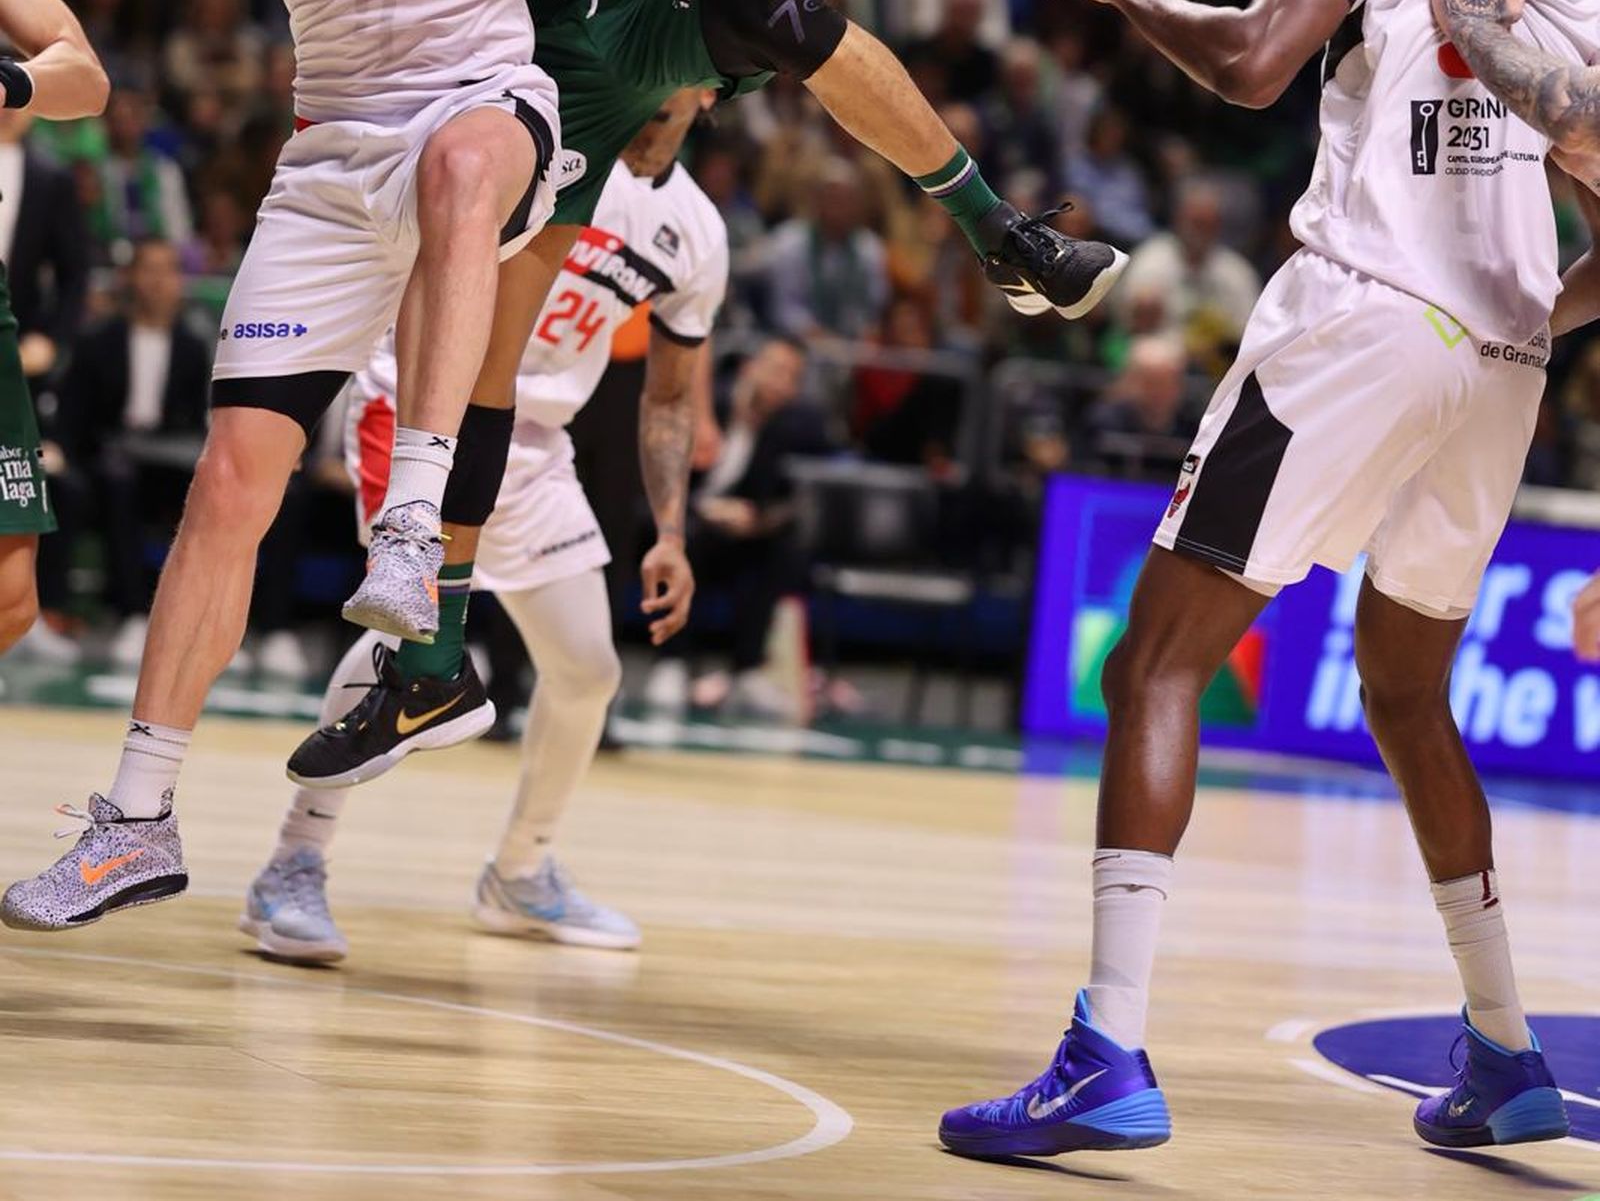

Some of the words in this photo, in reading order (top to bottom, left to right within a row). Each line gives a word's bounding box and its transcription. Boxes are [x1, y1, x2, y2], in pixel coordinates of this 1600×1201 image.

[1446, 125, 1490, 150] 2031
[537, 289, 606, 354] 24
[1480, 341, 1500, 358] de
